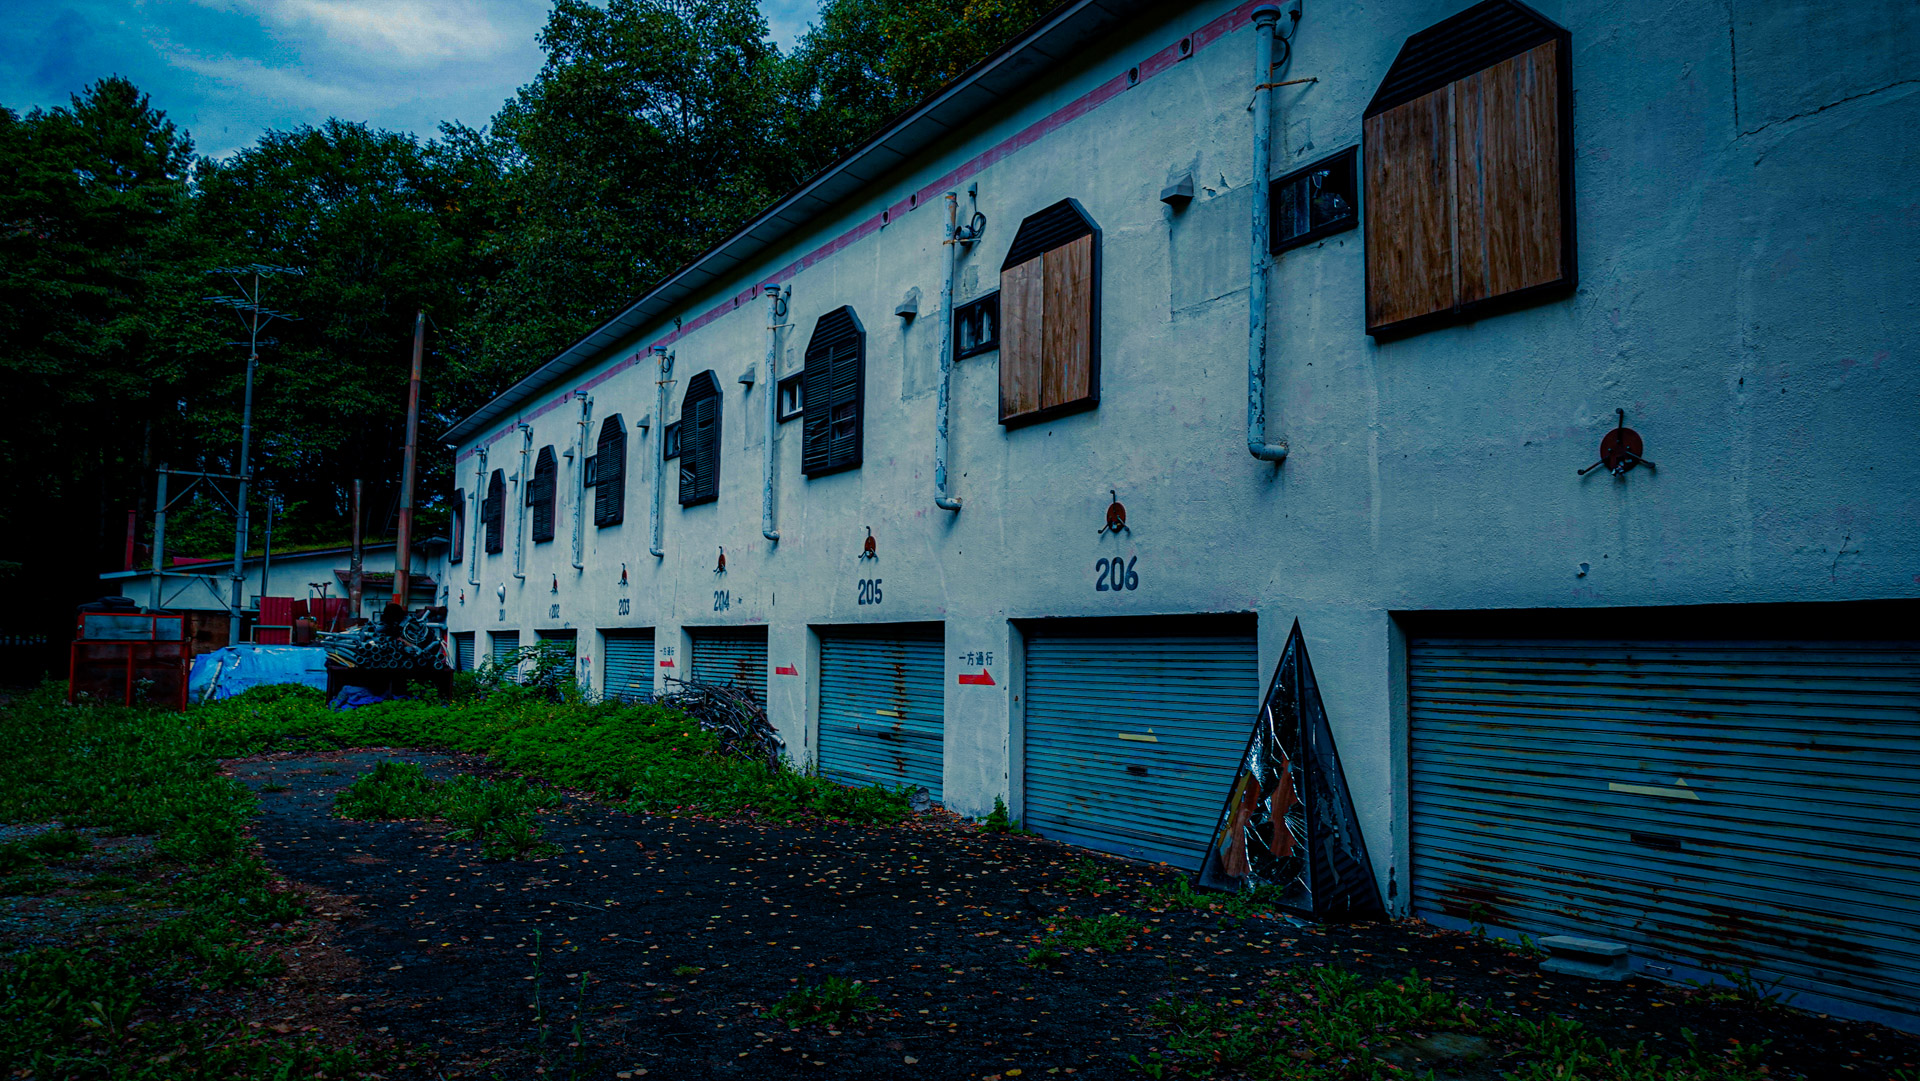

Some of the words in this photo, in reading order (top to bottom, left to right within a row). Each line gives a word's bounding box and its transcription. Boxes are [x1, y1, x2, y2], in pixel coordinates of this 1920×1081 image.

[1095, 556, 1138, 591] 206
[713, 590, 730, 611] 204
[858, 579, 883, 605] 205
[618, 598, 630, 616] 203
[958, 651, 993, 666] 一方通行
